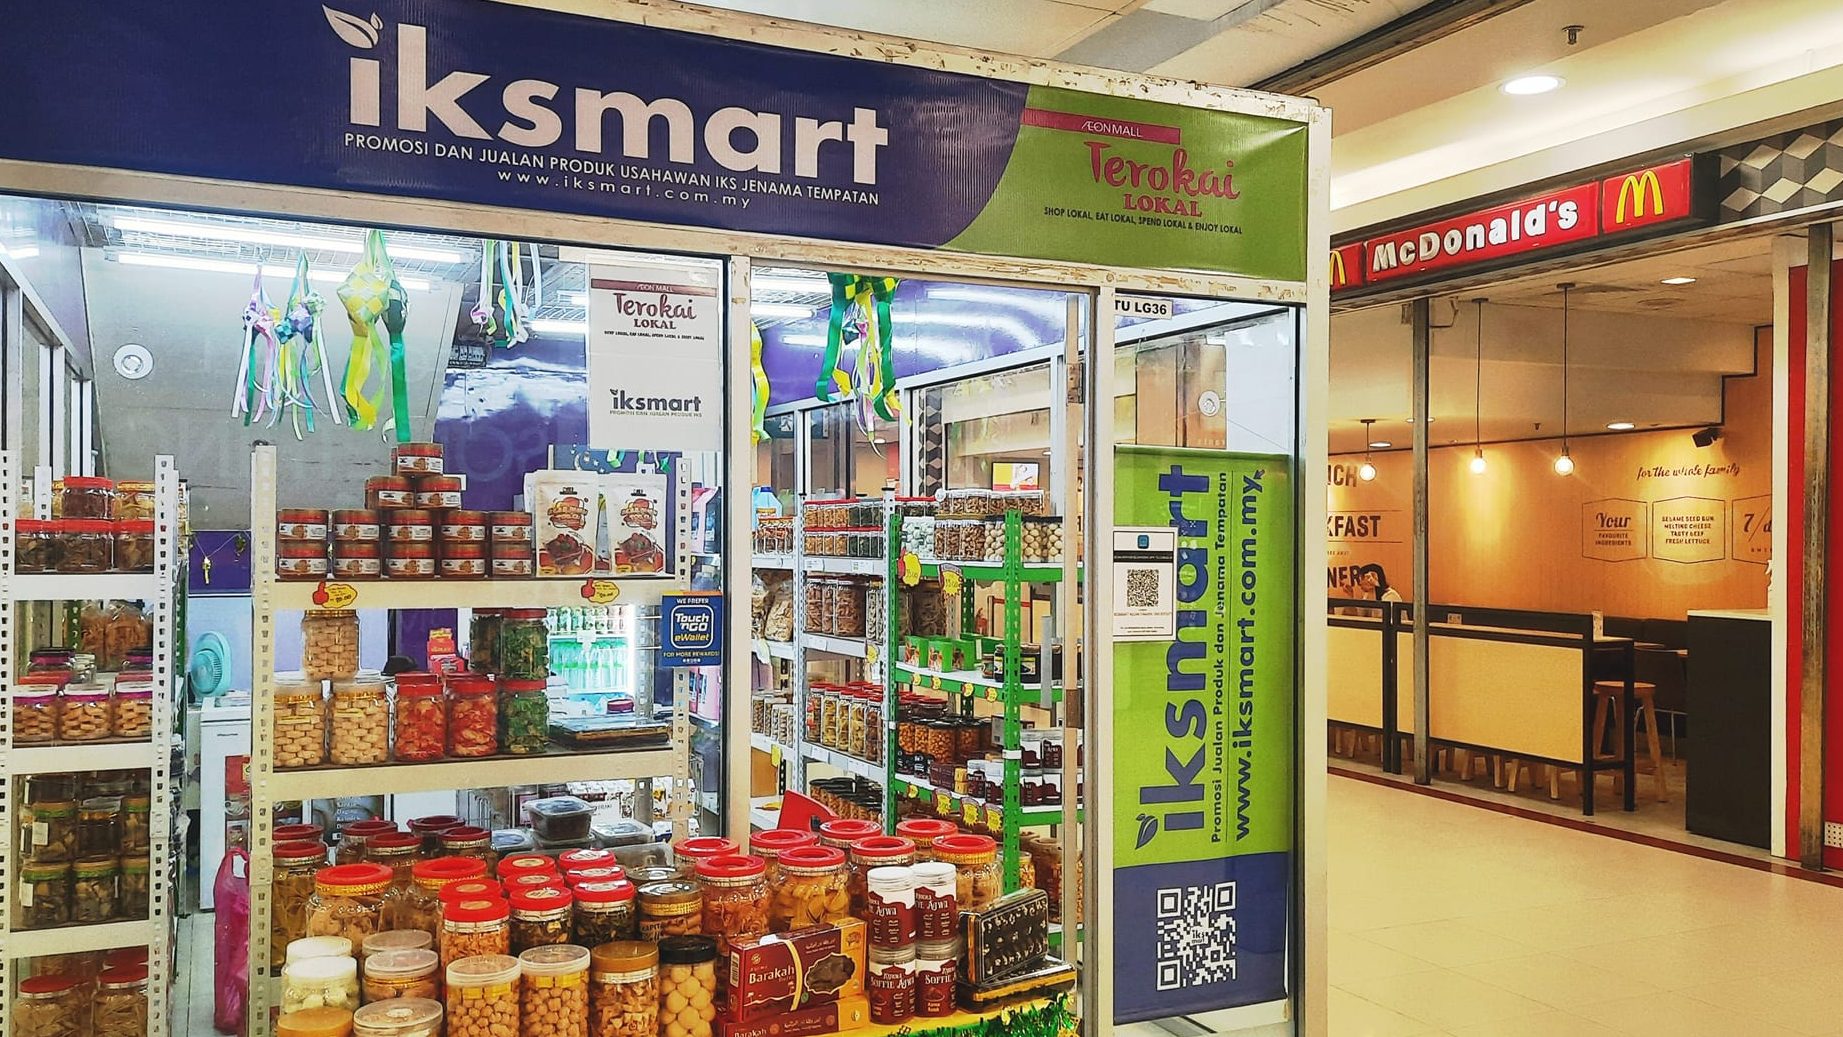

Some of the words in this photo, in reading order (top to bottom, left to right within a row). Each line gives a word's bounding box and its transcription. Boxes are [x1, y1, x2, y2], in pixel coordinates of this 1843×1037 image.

[350, 23, 889, 185] iksmart
[345, 133, 428, 155] PROMOSI
[435, 143, 473, 160] DAN
[479, 149, 544, 168] JUALAN
[551, 157, 615, 177] PRODUK
[621, 165, 710, 187] USAHAWAN
[716, 176, 737, 190] IKS
[742, 179, 802, 197] JENAMA
[806, 185, 879, 205] TEMPATAN
[1083, 141, 1240, 199] Terokai
[498, 170, 750, 209] www.iksmart.com.my
[1123, 194, 1203, 218] LOKAL
[1044, 206, 1065, 217] SHOP
[1096, 212, 1109, 222] EAT
[1111, 213, 1136, 225] LOKAL,
[1138, 216, 1162, 227] SPEND
[1163, 219, 1187, 229] LOKAL
[1195, 223, 1218, 233] ENJOY
[1220, 225, 1243, 235] LOKAL
[1373, 199, 1579, 272] McDonald's
[612, 292, 697, 320] Terokai
[633, 318, 677, 329] LOKAL
[1135, 302, 1167, 315] LG36
[612, 390, 701, 412] iksmart
[1215, 472, 1228, 550] Tempatan
[1595, 512, 1631, 528] Your
[1214, 555, 1225, 618] Jenama
[675, 612, 710, 623] Touch
[674, 633, 709, 642] eWallet
[1140, 465, 1209, 831] iksmart
[1214, 623, 1224, 653] dan
[1232, 475, 1263, 842] www.iksmart.com.my
[1213, 658, 1224, 716] Produk
[1212, 721, 1223, 774] Jualan
[1211, 779, 1223, 843] Promosi
[749, 965, 794, 984] Barakah
